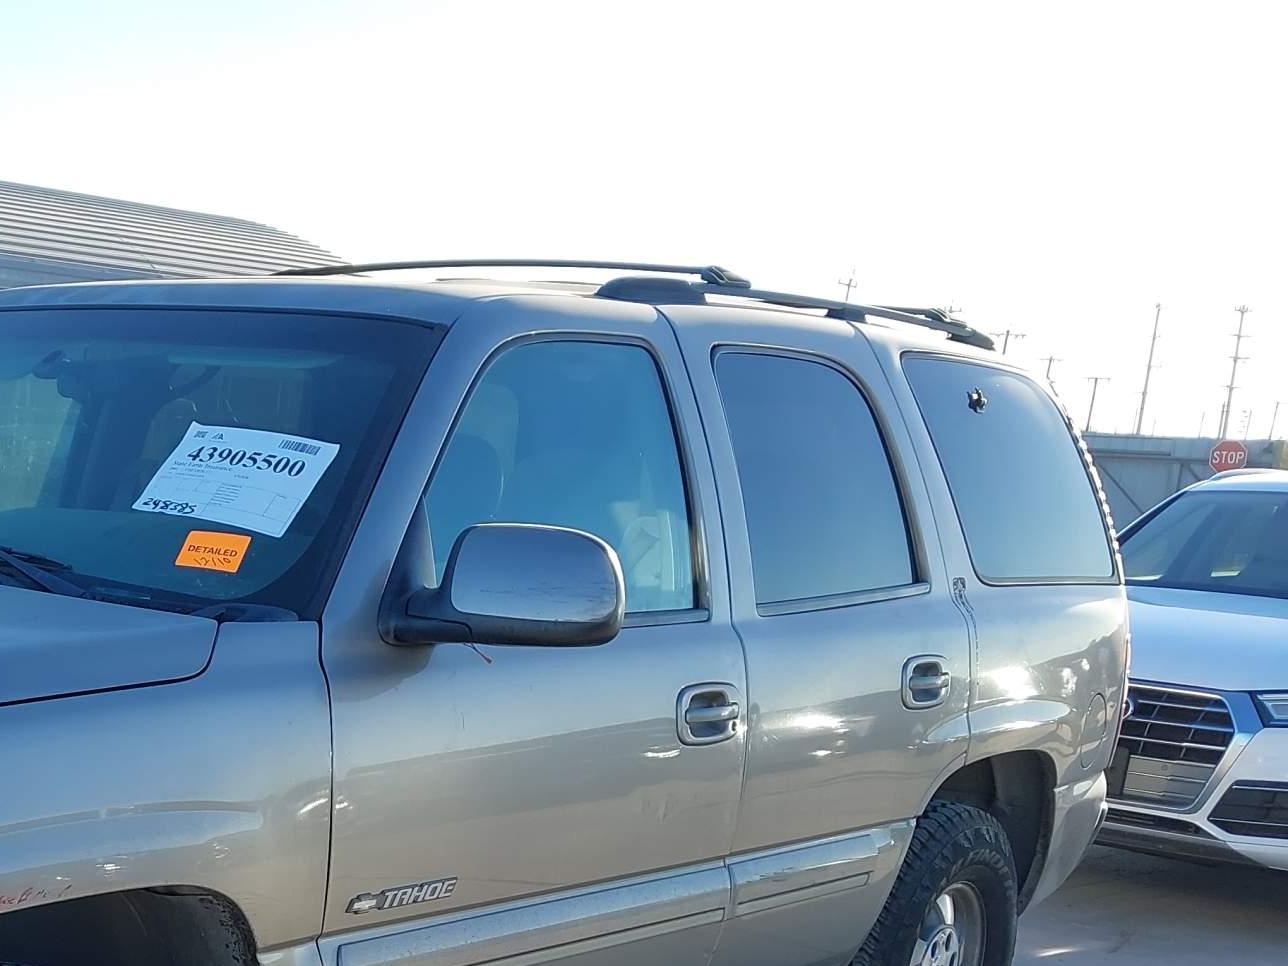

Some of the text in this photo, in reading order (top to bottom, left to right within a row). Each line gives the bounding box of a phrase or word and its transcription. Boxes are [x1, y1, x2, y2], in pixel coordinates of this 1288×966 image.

[187, 446, 306, 477] 43905500
[1212, 451, 1244, 464] STOP
[188, 544, 238, 557] DETAILED
[383, 879, 457, 909] TAHOE
